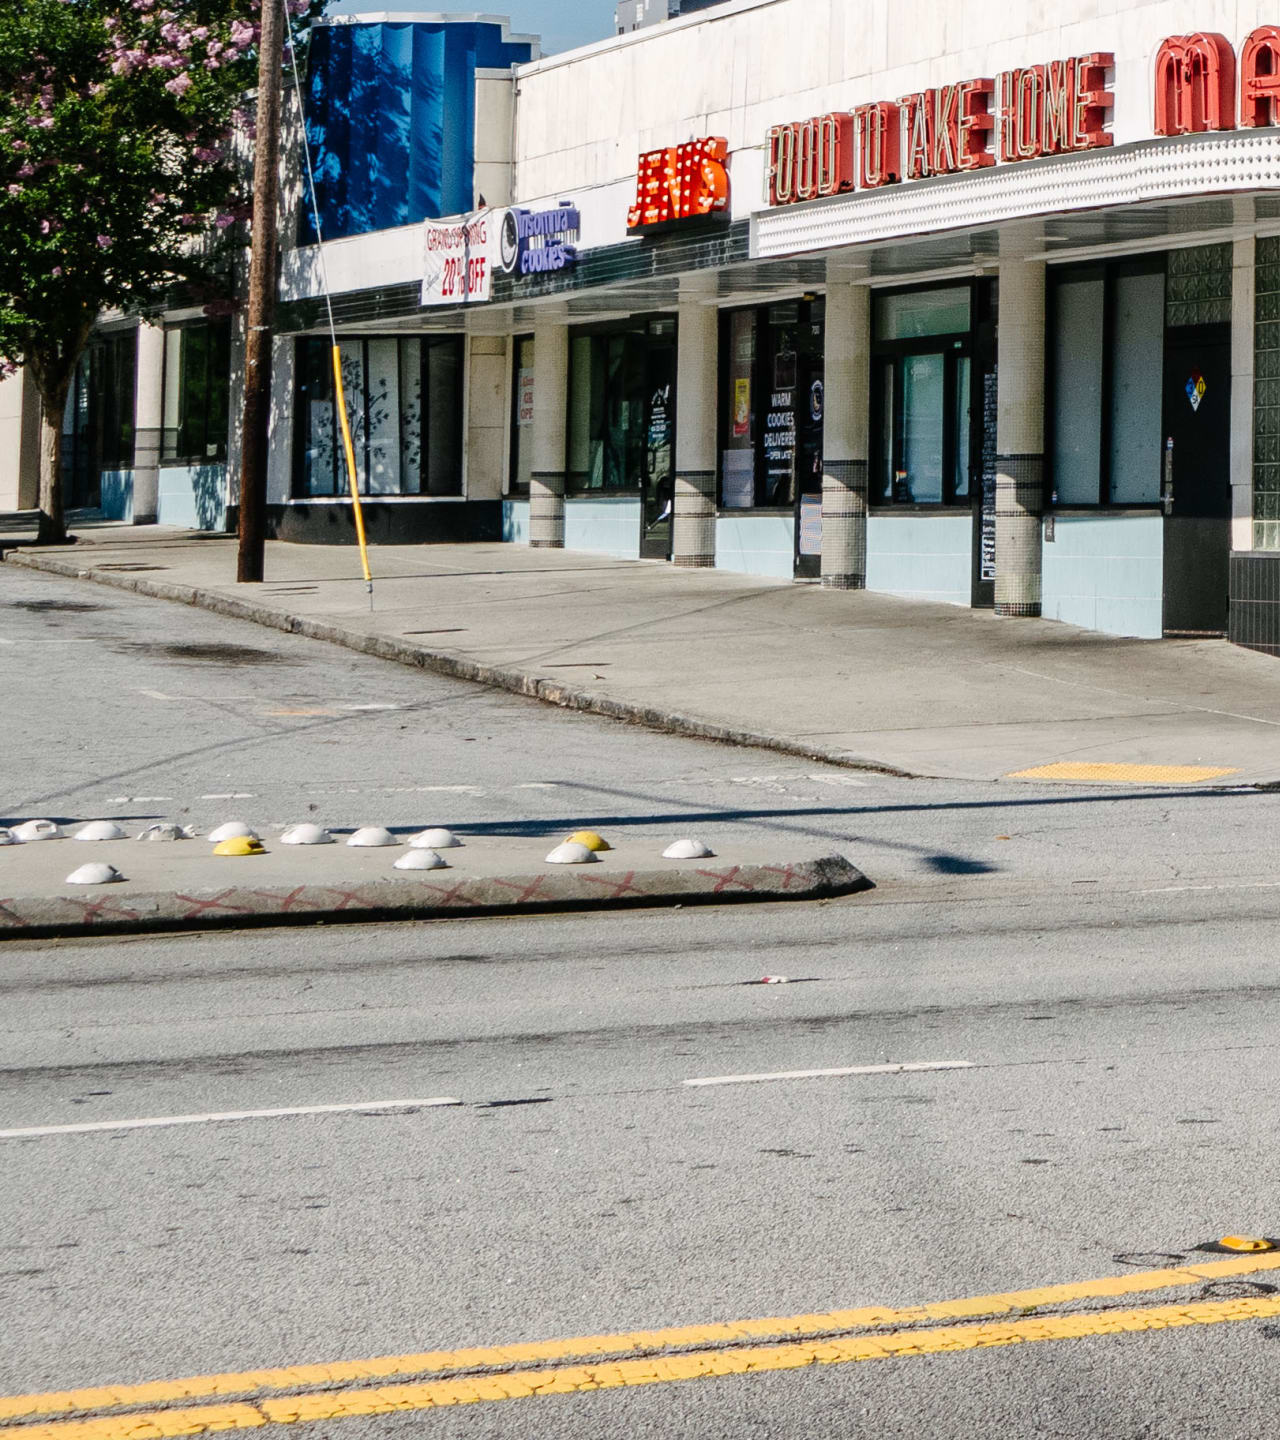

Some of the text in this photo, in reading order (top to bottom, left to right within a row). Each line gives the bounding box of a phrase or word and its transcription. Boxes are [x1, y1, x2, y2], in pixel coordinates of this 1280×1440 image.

[762, 52, 1115, 206] FOOD TO TAKE HOME
[468, 257, 486, 293] OFF
[771, 392, 791, 407] WARM
[767, 412, 795, 428] COOKIES
